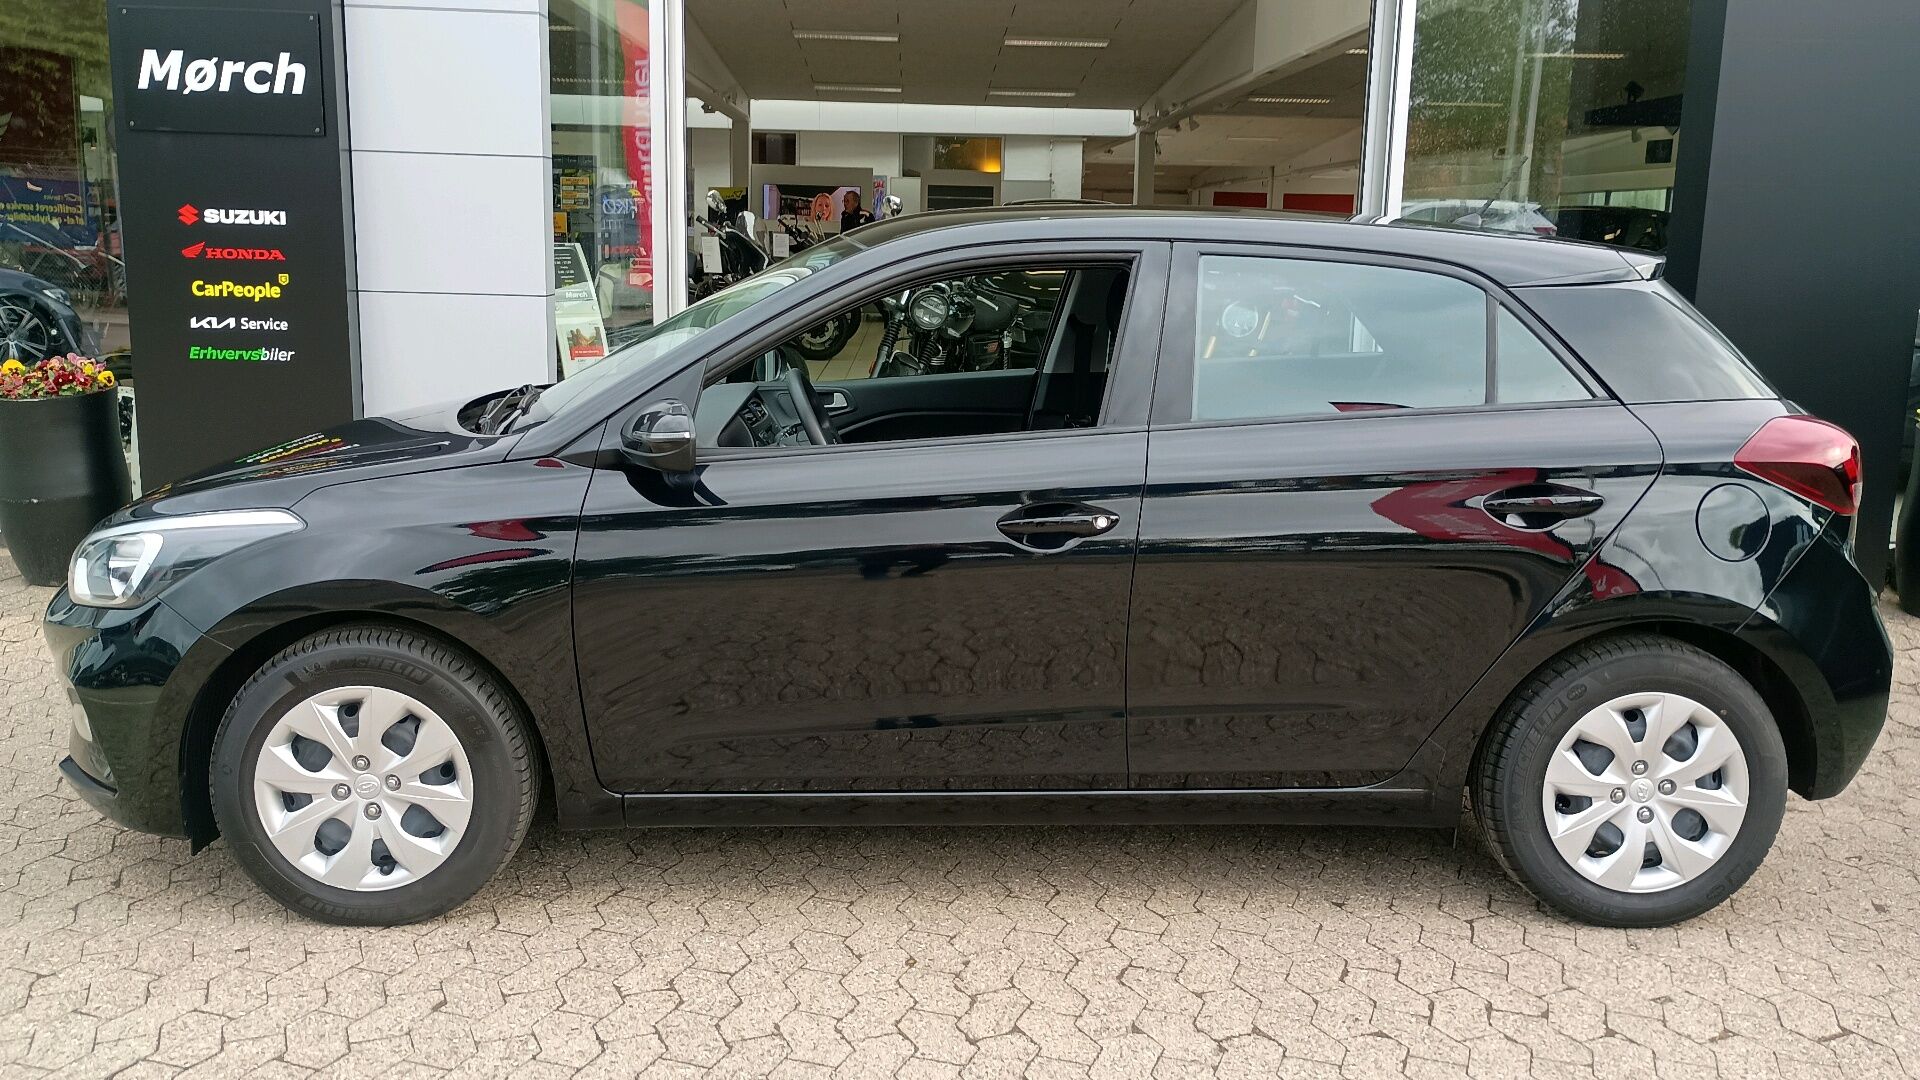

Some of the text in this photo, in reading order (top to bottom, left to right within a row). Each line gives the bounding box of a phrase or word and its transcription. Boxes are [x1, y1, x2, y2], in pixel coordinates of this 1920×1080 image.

[137, 48, 306, 95] Mørch
[203, 208, 287, 226] SUZUKI
[205, 247, 286, 261] HONDA
[191, 279, 282, 303] CarPeople
[190, 316, 289, 331] KIA Service
[189, 346, 296, 362] Erhvervsbiler
